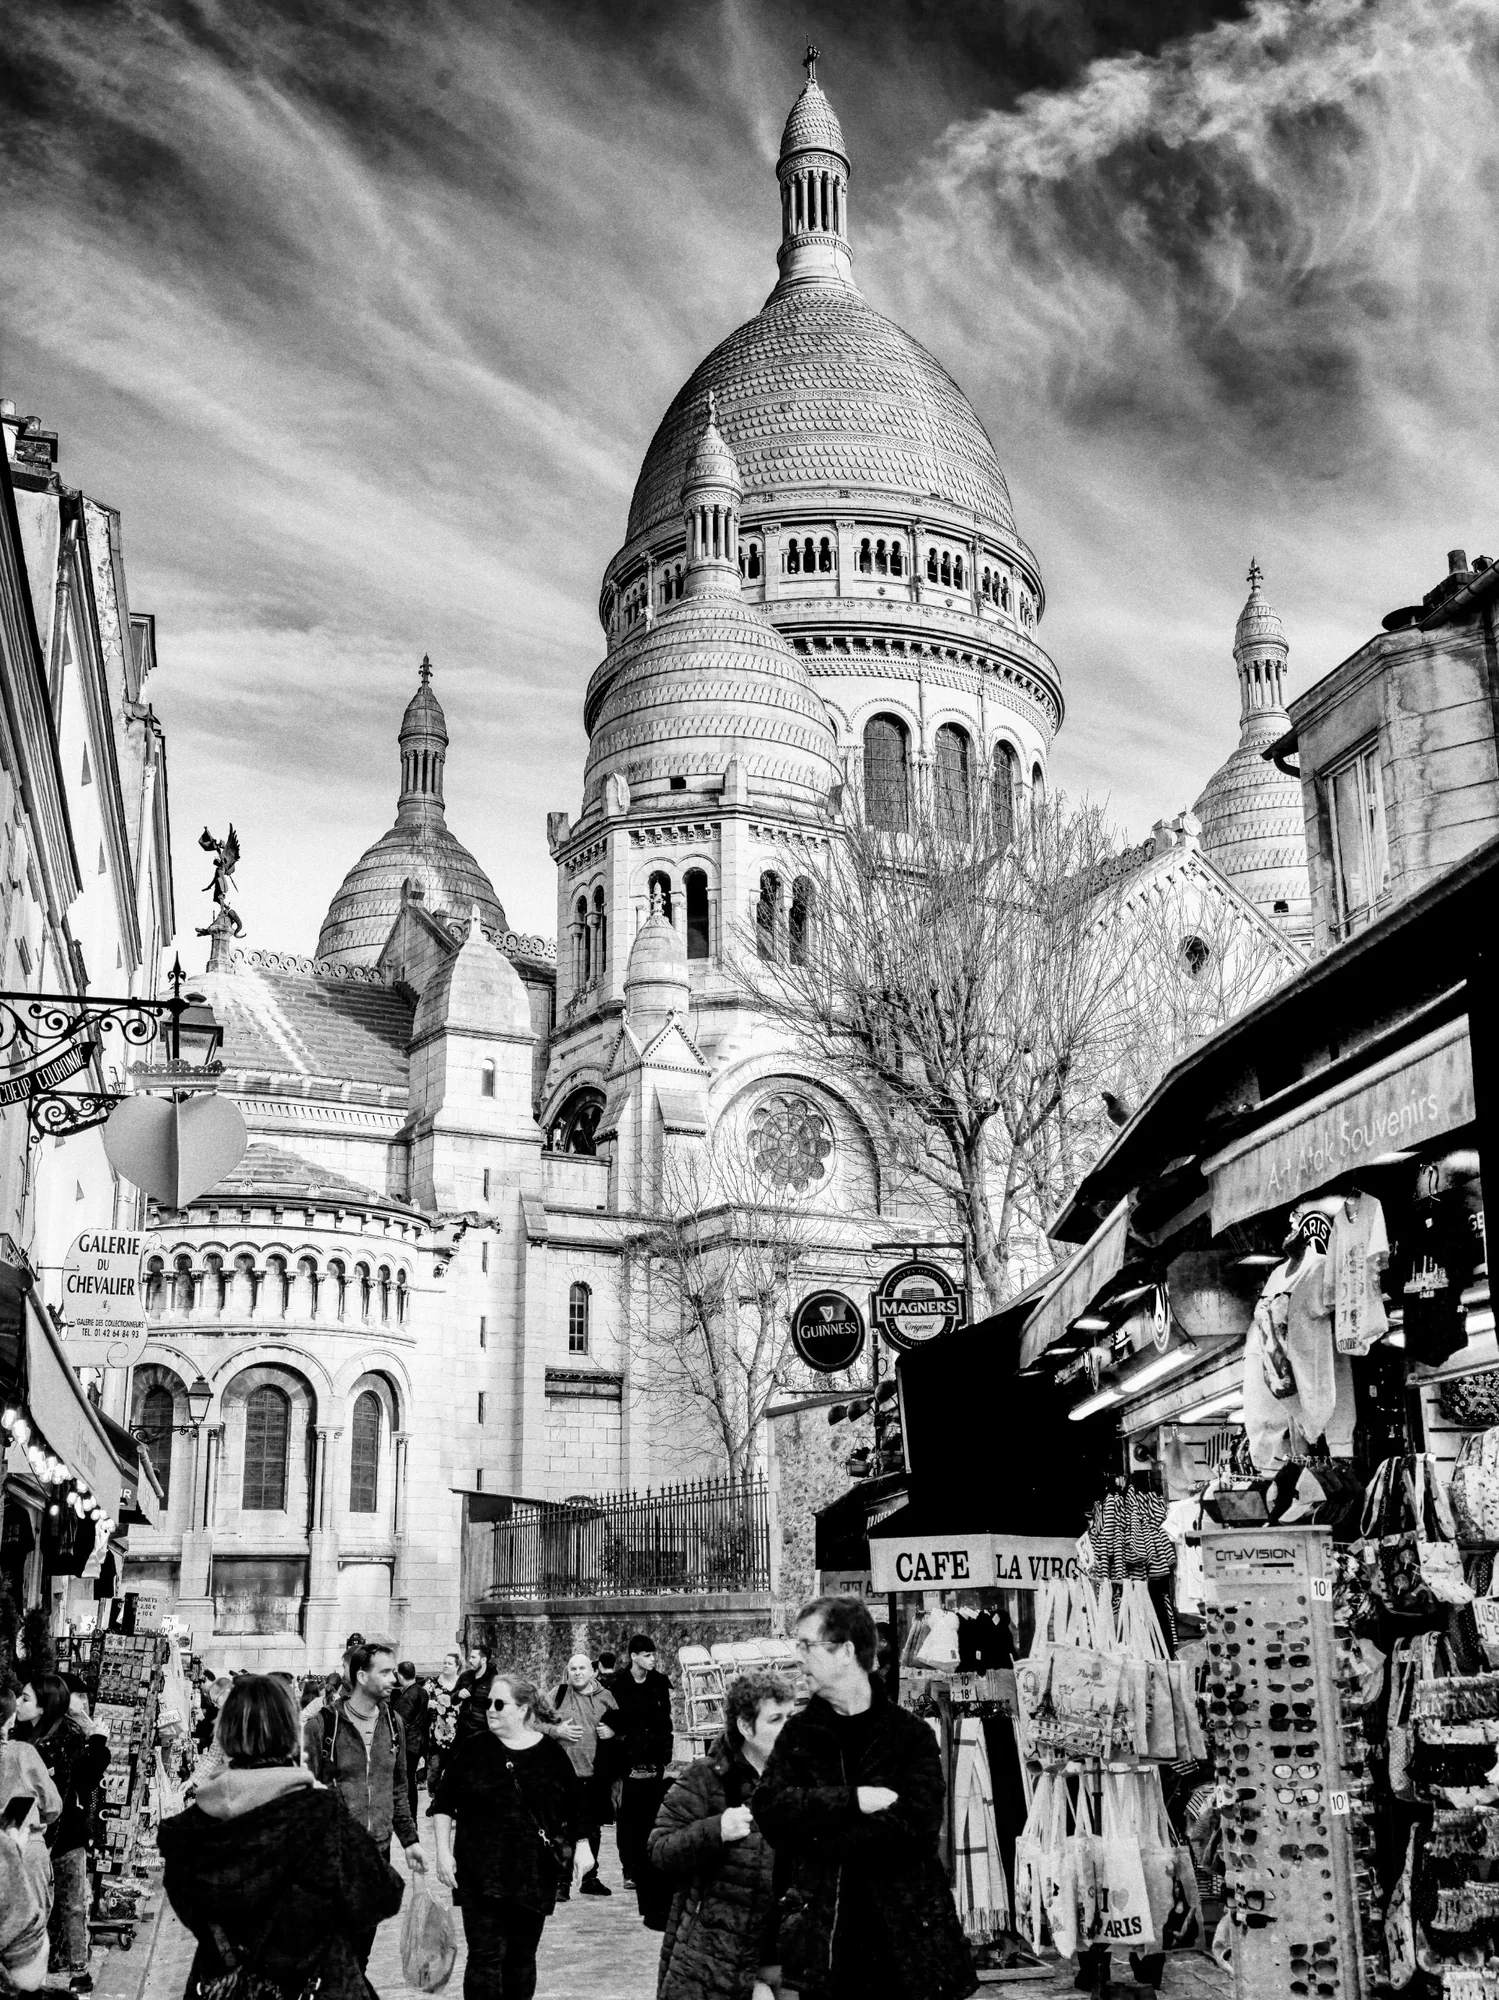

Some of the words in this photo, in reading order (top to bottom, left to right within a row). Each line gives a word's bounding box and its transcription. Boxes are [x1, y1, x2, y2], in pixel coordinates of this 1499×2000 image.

[1339, 1088, 1439, 1158] Souvenirs
[1302, 1218, 1328, 1240] ARIS
[78, 1234, 141, 1256] GALERIE
[97, 1258, 110, 1271] DU
[66, 1274, 135, 1296] CHEVALIER
[881, 1300, 957, 1316] MAGNERS
[94, 1328, 101, 1337] 01
[102, 1329, 110, 1338] 42
[112, 1330, 120, 1338] 64
[121, 1330, 129, 1338] 84
[131, 1330, 139, 1339] 93
[801, 1321, 858, 1340] GUINNESS
[904, 1322, 936, 1334] Original
[896, 1551, 970, 1583] CAFE
[996, 1554, 1023, 1580] LA
